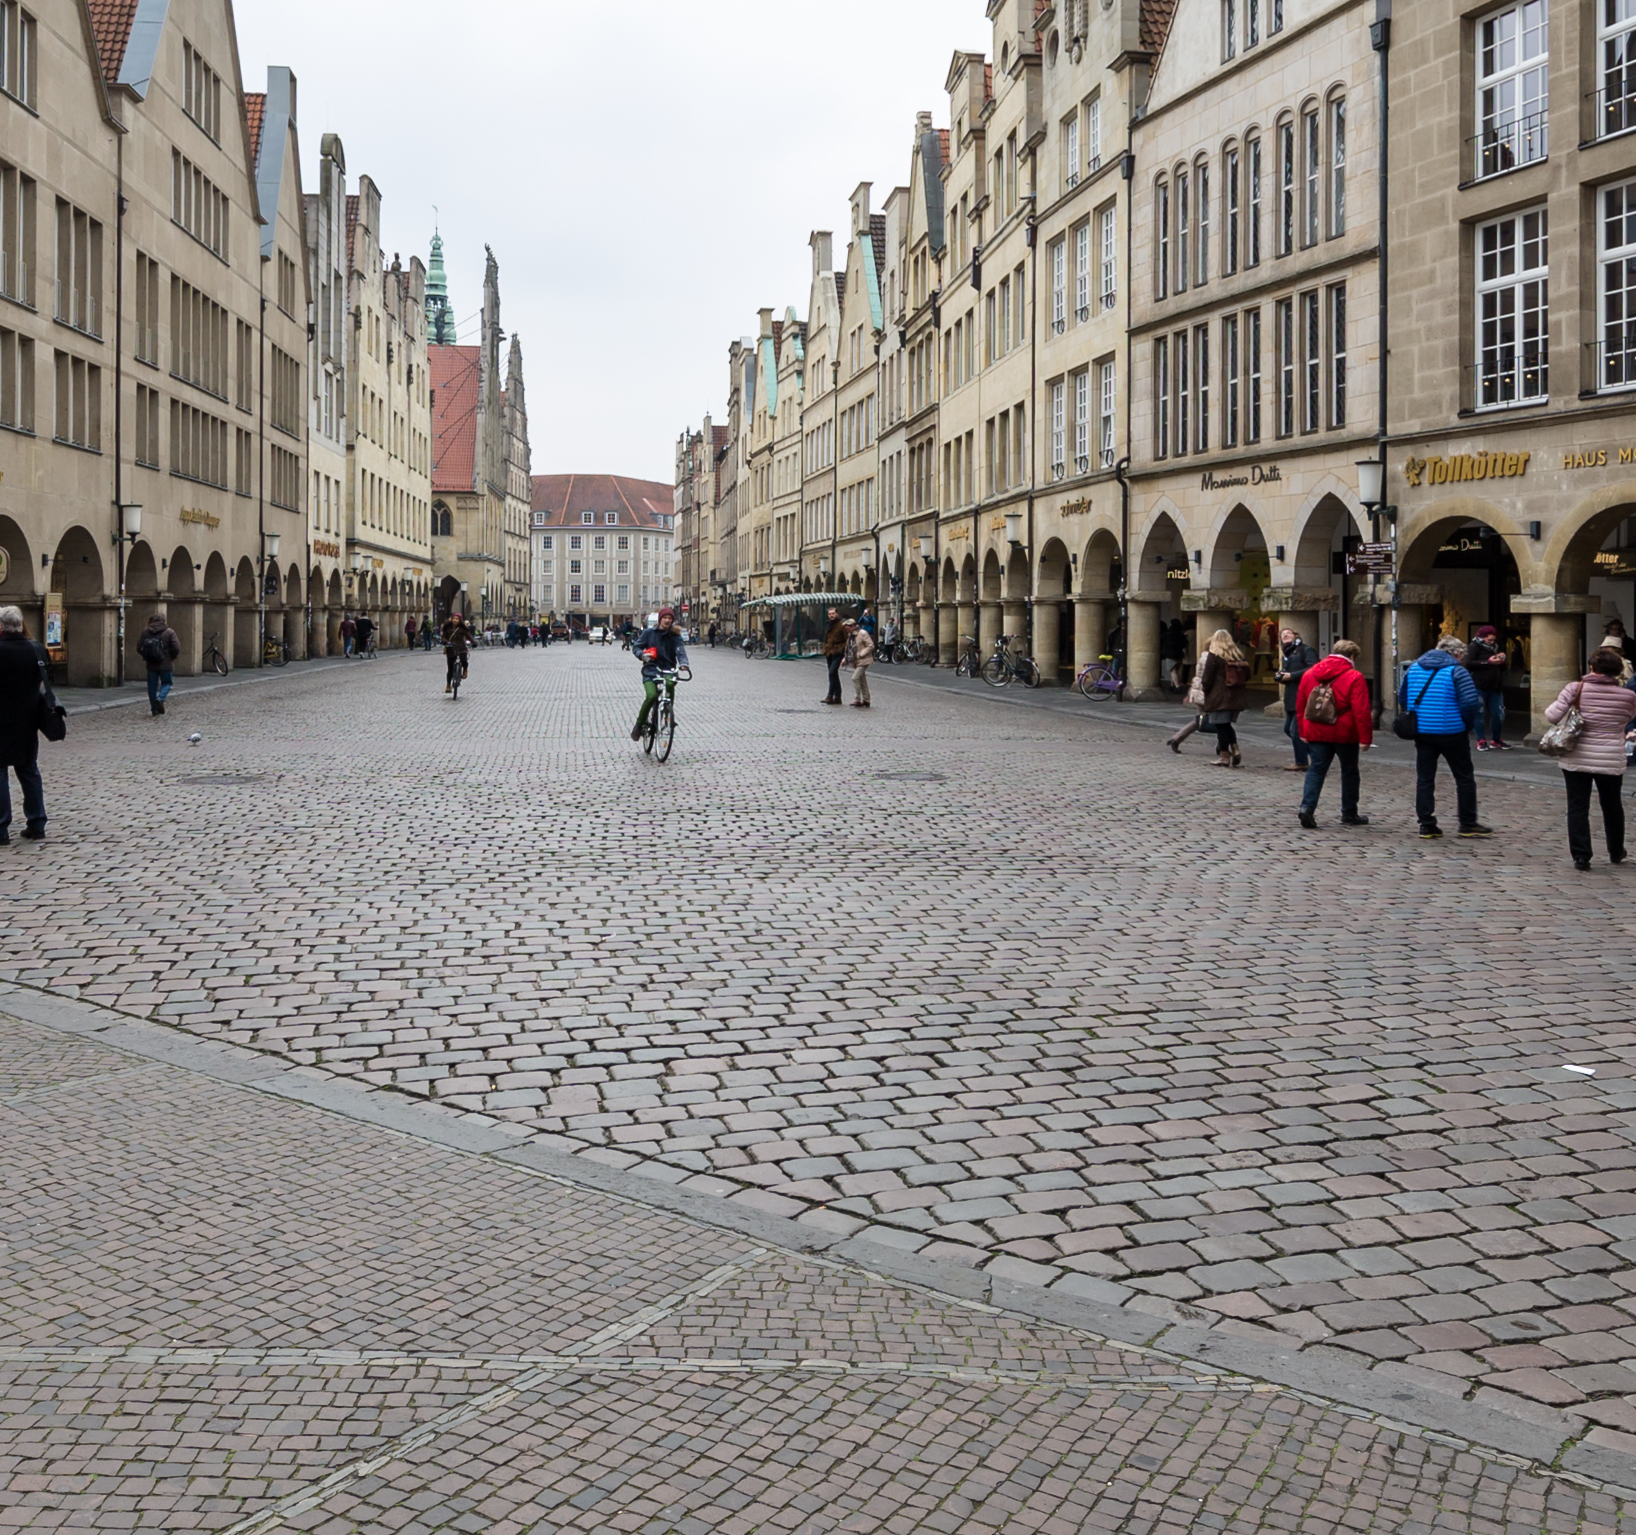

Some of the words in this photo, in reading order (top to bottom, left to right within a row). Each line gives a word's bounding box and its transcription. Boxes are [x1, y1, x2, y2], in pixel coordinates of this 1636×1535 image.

[1426, 450, 1531, 485] Tollkötter
[1563, 449, 1607, 470] HAUS
[1201, 472, 1249, 492] Massimo
[1250, 465, 1283, 486] Dutti
[1594, 552, 1619, 563] ötter
[1167, 568, 1192, 580] nitzl
